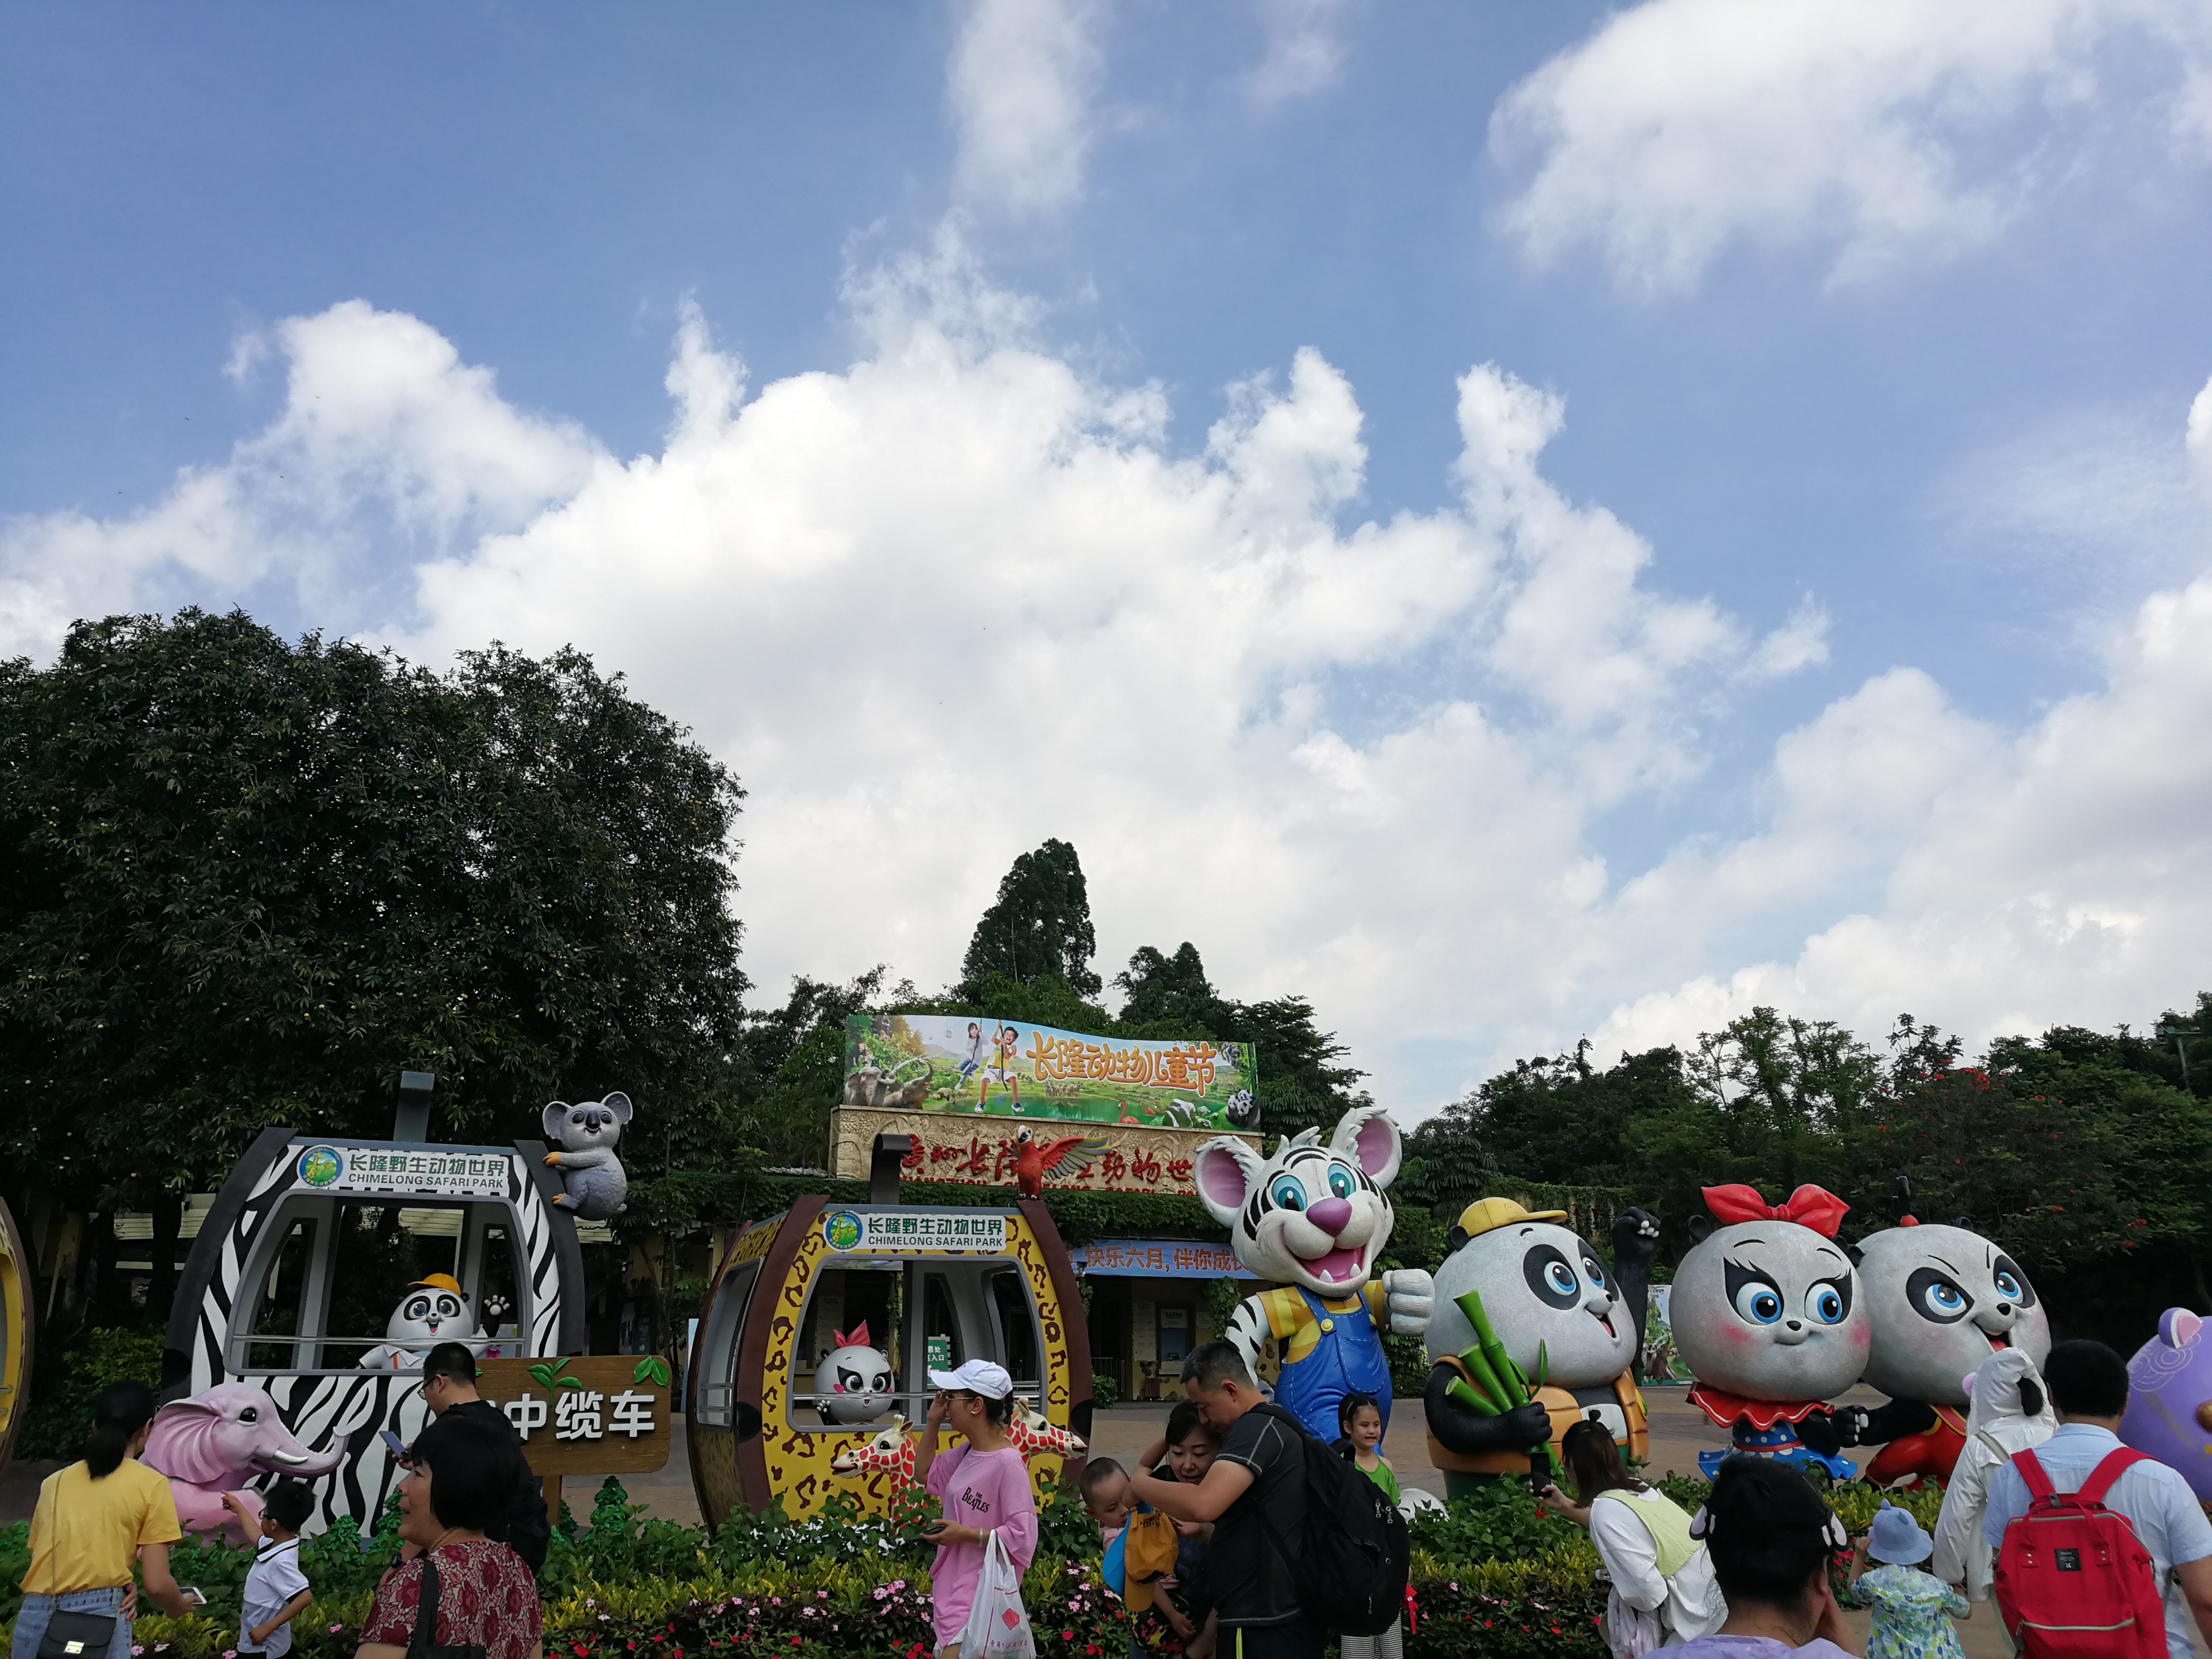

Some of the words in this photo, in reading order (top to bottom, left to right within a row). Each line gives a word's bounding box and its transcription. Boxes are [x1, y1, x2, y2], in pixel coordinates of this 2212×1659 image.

[1026, 1031, 1217, 1097] 长隆动物儿童节
[350, 1154, 505, 1176] 长隆野生动物世界
[348, 1173, 423, 1185] CHIMELONG
[426, 1176, 469, 1187] SAFARI
[472, 1178, 503, 1188] PARK
[869, 1217, 1002, 1235] 长隆野生动物世界
[869, 1236, 933, 1245] CHIMELONG
[935, 1237, 973, 1246] SAFARI
[976, 1238, 1002, 1246] PARK
[483, 1389, 656, 1440] 中缆车
[962, 1487, 990, 1513] BEATLES
